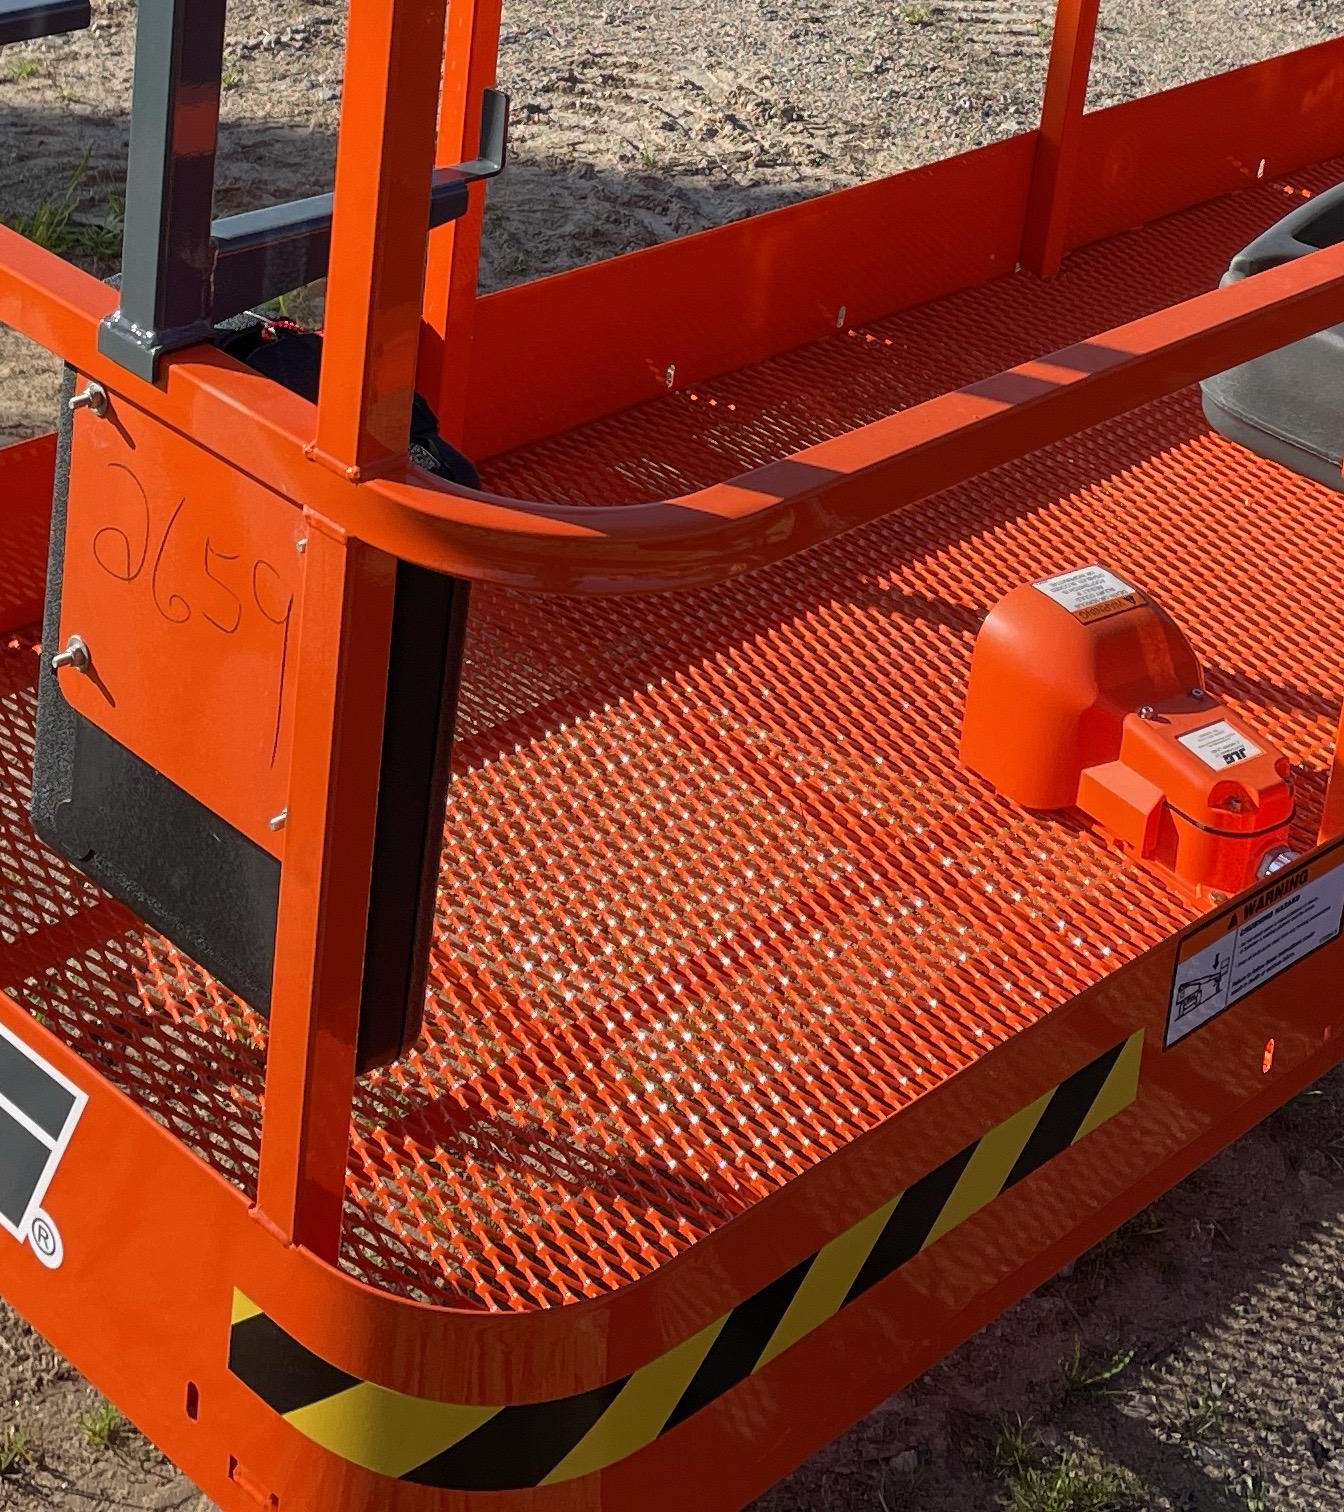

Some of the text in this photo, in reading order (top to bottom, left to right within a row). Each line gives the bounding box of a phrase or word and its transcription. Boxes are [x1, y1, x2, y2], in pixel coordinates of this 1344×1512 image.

[92, 462, 296, 770] 2659
[1222, 747, 1247, 765] JLG
[1243, 869, 1310, 918] WARNING
